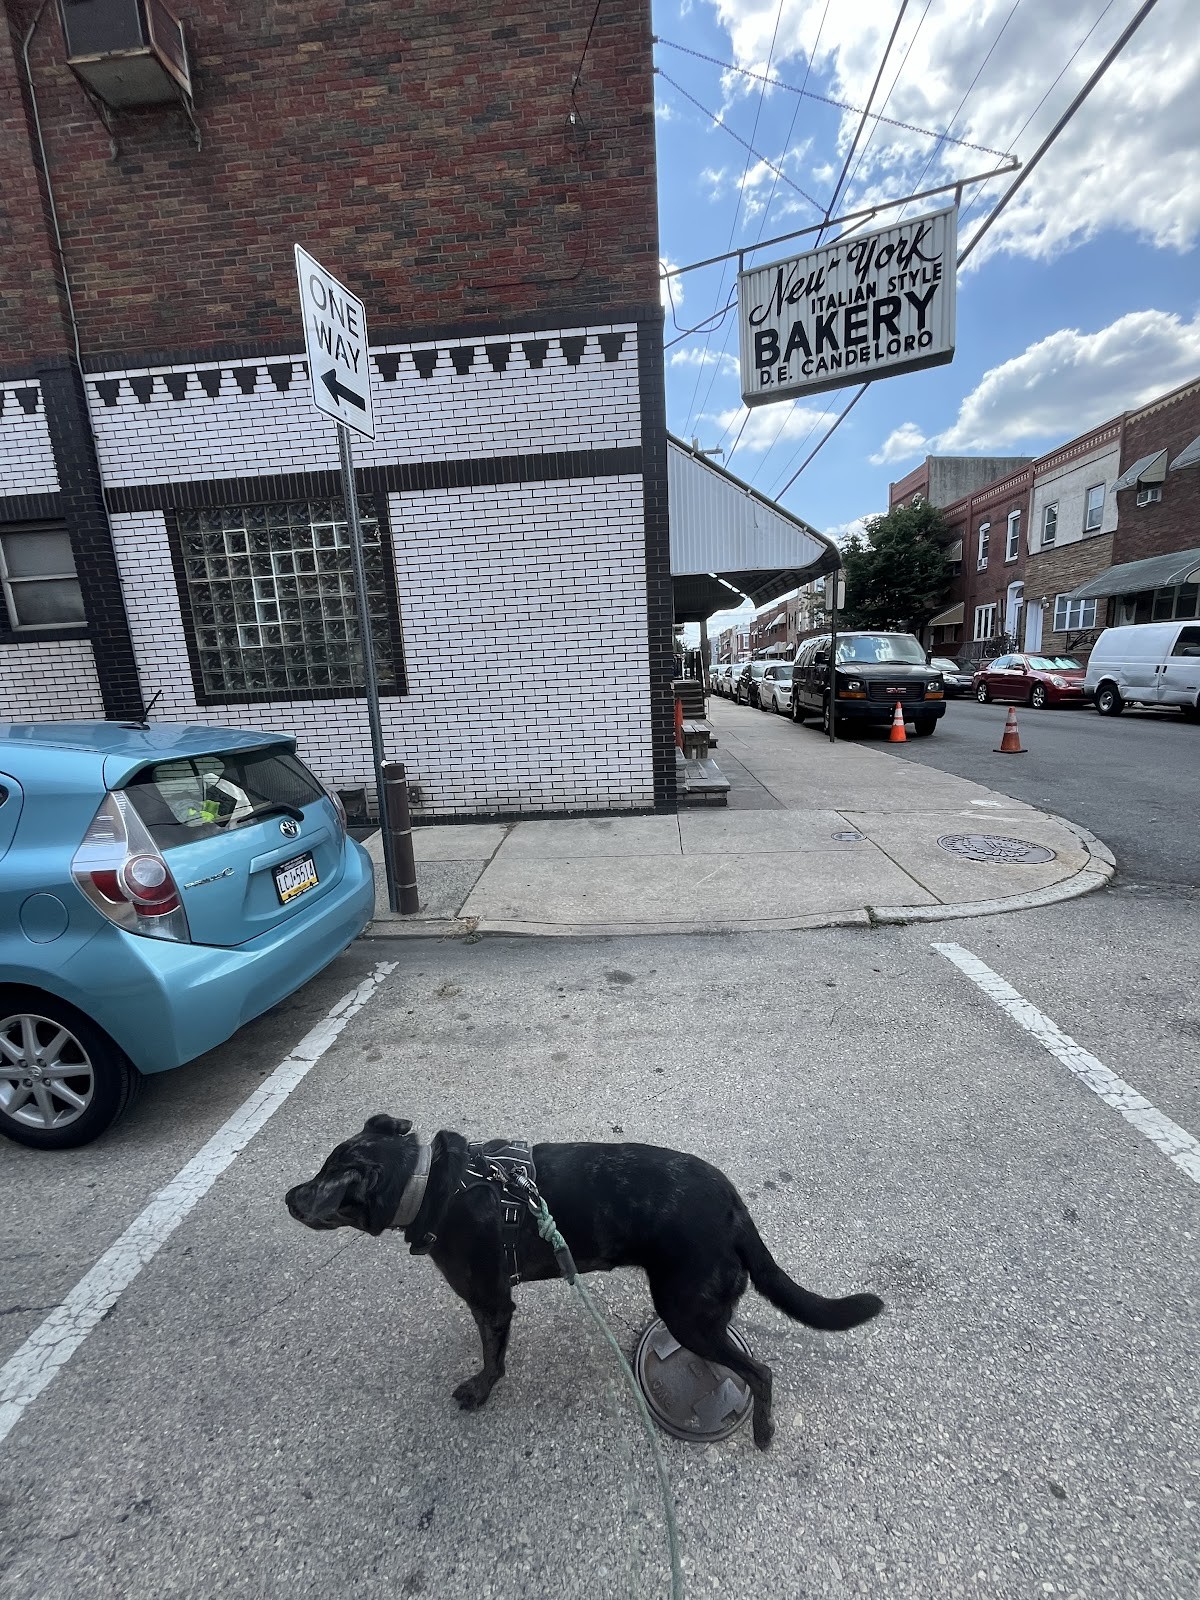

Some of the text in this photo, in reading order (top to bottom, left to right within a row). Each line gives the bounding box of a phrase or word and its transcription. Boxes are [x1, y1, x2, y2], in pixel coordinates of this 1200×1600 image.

[847, 224, 943, 284] York
[309, 274, 359, 339] ONE
[811, 262, 942, 314] ITALIAN STYLE
[313, 314, 360, 374] WAY
[754, 284, 939, 369] BAKERY
[760, 330, 933, 385] D.E. CANDELORO
